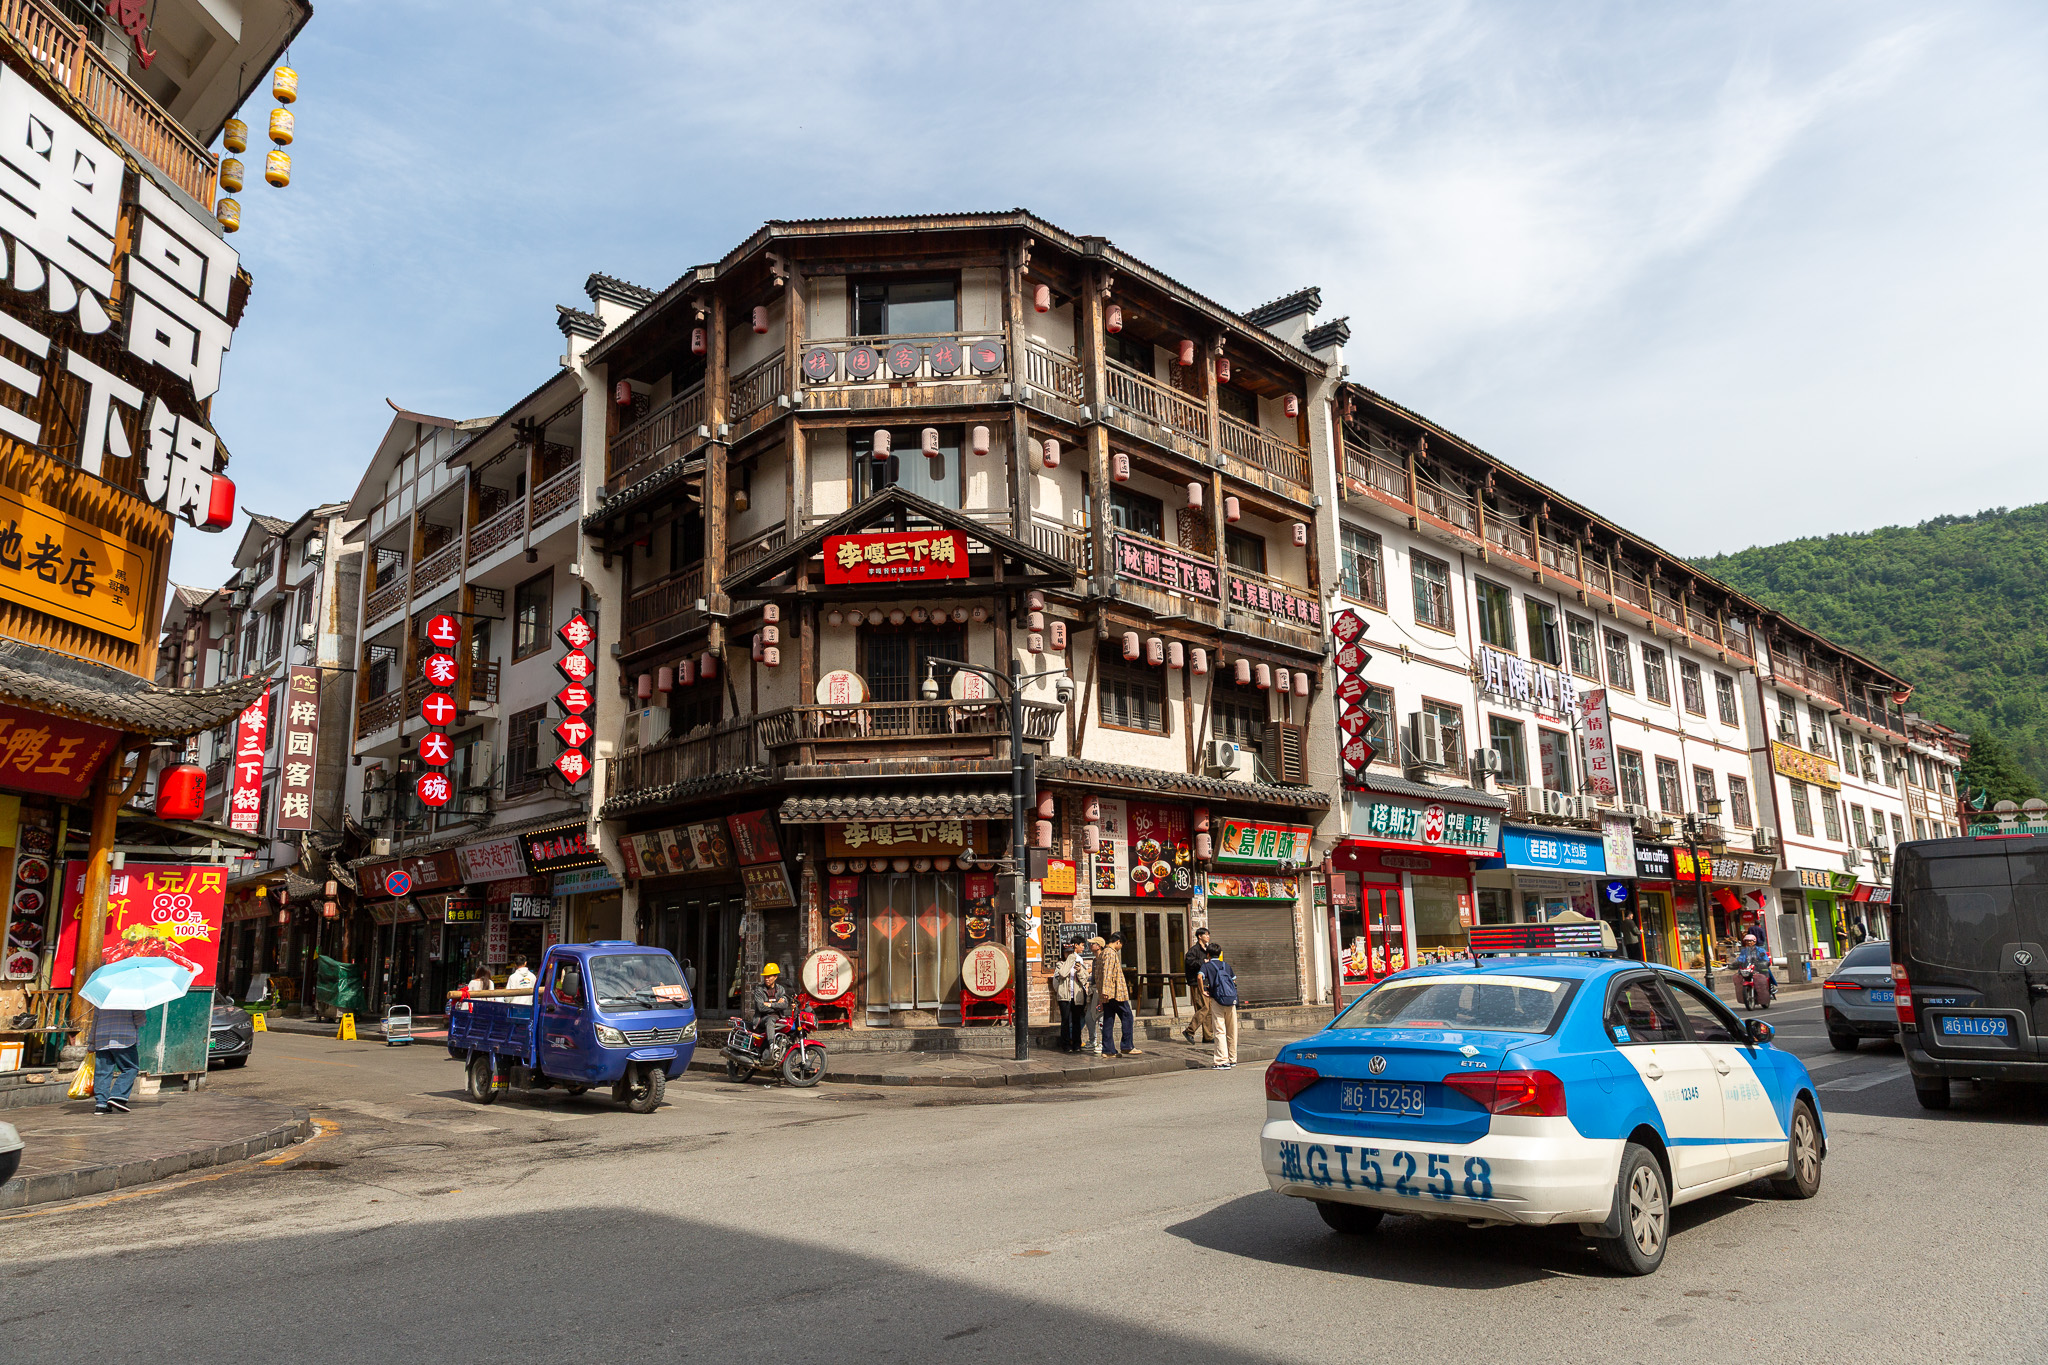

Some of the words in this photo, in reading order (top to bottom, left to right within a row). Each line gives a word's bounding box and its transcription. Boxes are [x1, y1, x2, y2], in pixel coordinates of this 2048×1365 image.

[836, 535, 956, 569] 李嘎三下锅
[1123, 544, 1212, 593] 秘制三下锅
[1232, 578, 1321, 625] 土家里的老味道
[560, 621, 591, 776] 李嘎三下锅
[1338, 615, 1366, 762] 李嘎三下锅
[424, 618, 456, 801] 土家十大碗
[233, 691, 268, 812] 峰三下锅
[281, 700, 317, 820] 梓园客栈
[1585, 698, 1610, 791] 足情缘足浴
[843, 821, 964, 849] 李嘎三下锅
[1371, 803, 1422, 836] 塔斯汀
[543, 832, 594, 860] 杭州小笼
[1238, 827, 1297, 859] 葛根酥
[1530, 839, 1557, 860] 老百姓
[1562, 840, 1587, 858] 大药房
[1636, 847, 1652, 862] luckin
[1652, 849, 1670, 863] coffee
[143, 871, 222, 895] 1元/只
[448, 910, 482, 921] 特色餐厅
[512, 897, 550, 918] 平价超市
[174, 925, 209, 937] 100只
[489, 933, 507, 943] 饮料
[489, 943, 507, 953] 零食
[1280, 1140, 1493, 1201] 湘GT5258
